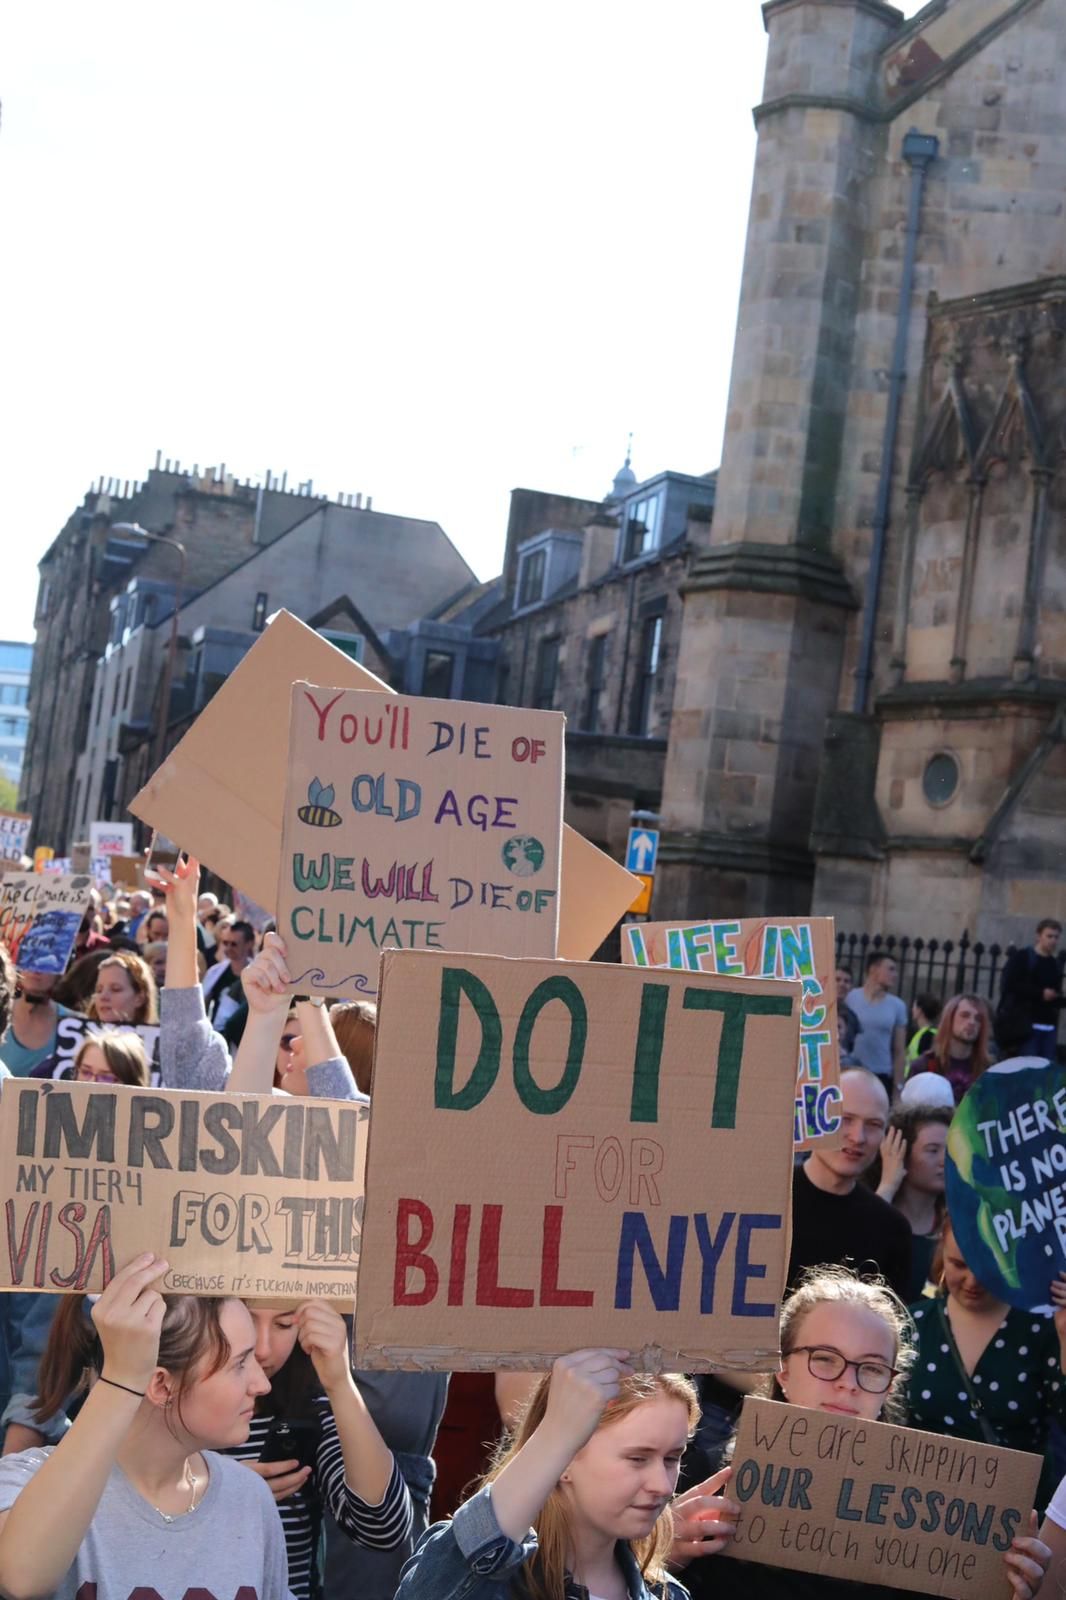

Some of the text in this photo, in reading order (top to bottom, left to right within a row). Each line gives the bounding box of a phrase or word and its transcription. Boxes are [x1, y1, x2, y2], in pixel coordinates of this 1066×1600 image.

[304, 691, 546, 763] You'll DIE OF
[351, 772, 518, 831] OLD AGE
[293, 853, 557, 913] WE WILL DIE OF
[290, 906, 447, 949] CLIMATE
[628, 920, 816, 978] LIFE IN
[434, 966, 588, 1115] DO
[630, 983, 793, 1129] IT
[16, 1083, 117, 1162] I'M
[977, 1087, 1066, 1158] THERE
[16, 1164, 143, 1206] MY TIER 4
[554, 1134, 664, 1205] FOR
[1000, 1144, 1066, 1191] IS NO
[6, 1199, 115, 1290] VISA
[169, 1190, 273, 1254] FOR
[992, 1182, 1066, 1253] PLANE
[256, 1279, 303, 1292] FUCKING
[393, 1198, 782, 1317] BILL NYE
[817, 1422, 867, 1466] are
[735, 1459, 1021, 1551] OUR LESSONS
[731, 1515, 976, 1581] to teach you one
